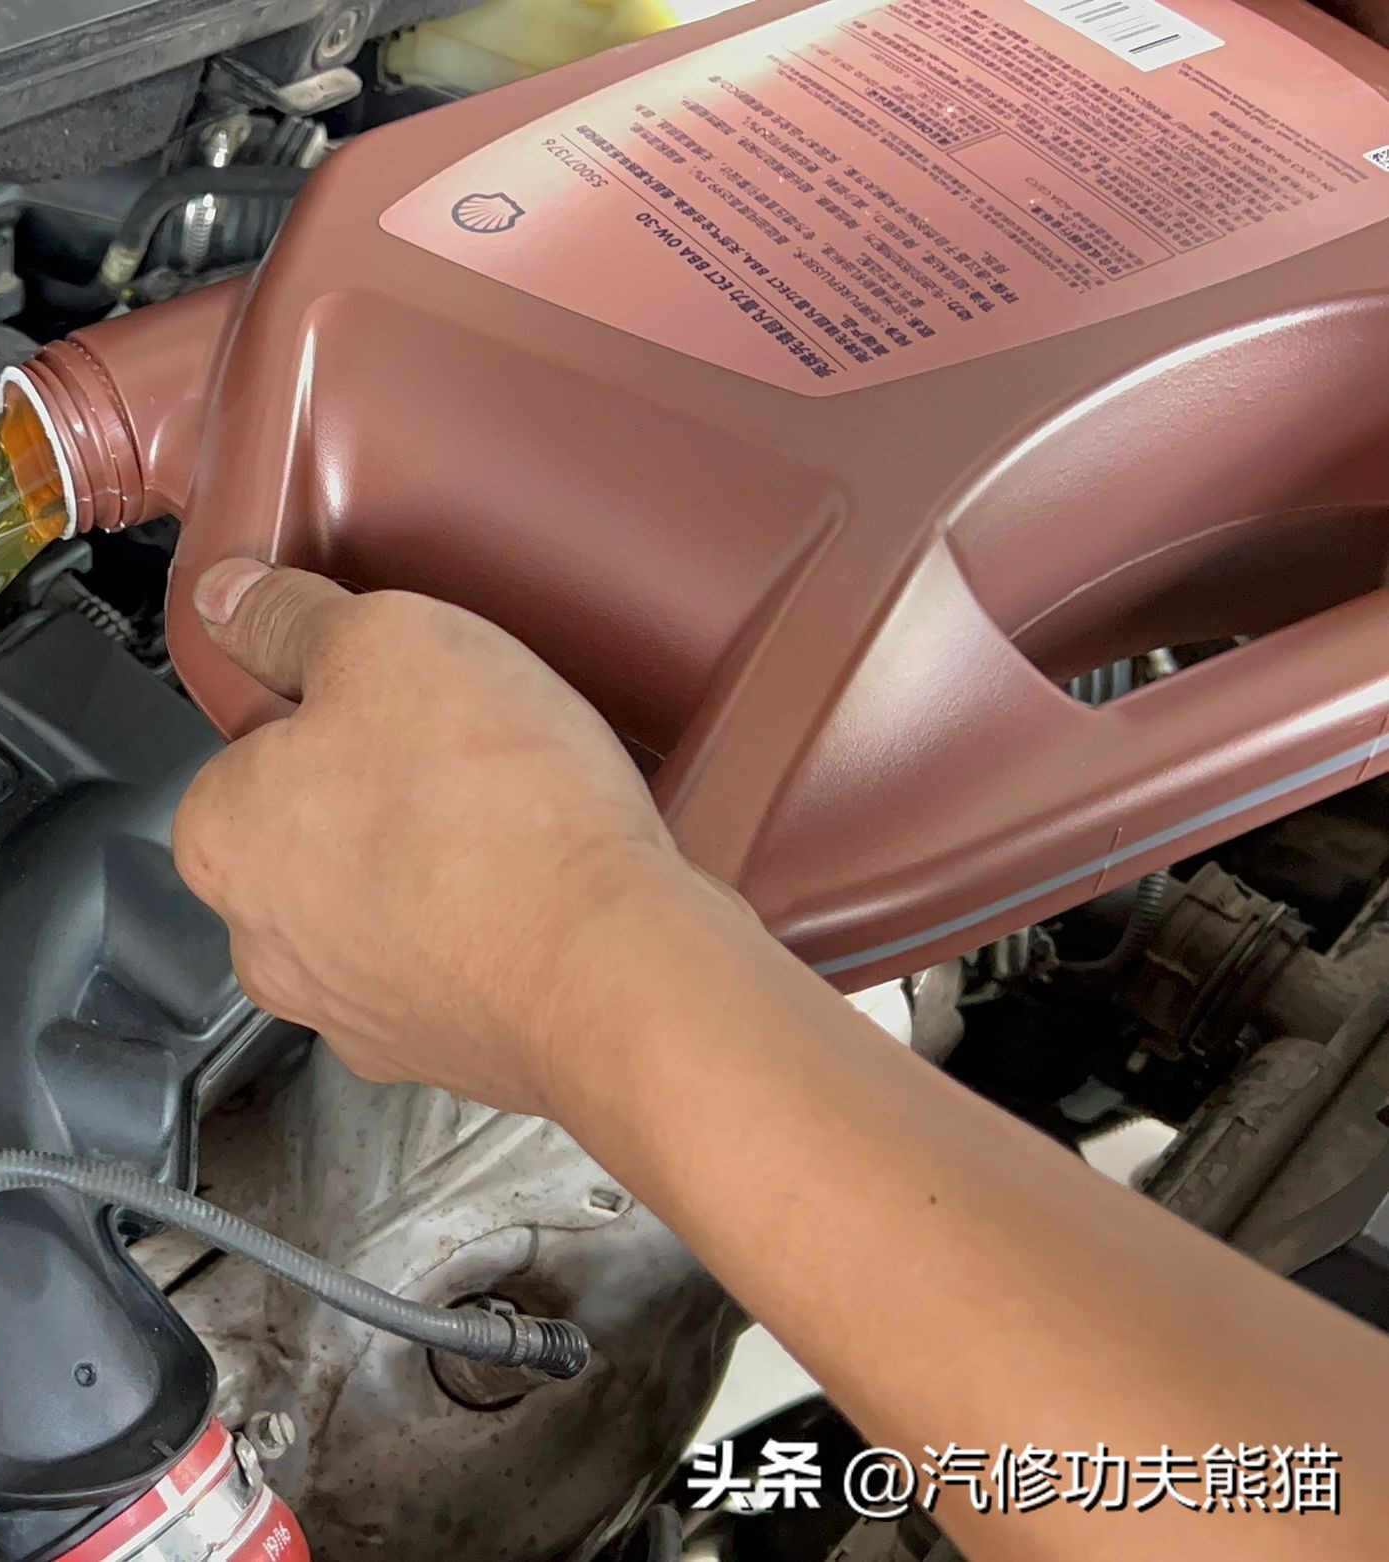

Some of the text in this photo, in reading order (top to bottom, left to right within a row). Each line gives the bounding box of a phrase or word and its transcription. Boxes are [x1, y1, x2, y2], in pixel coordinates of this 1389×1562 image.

[540, 137, 609, 189] 550071376
[633, 210, 839, 378] 壳牌先锋超凡喜力 ECT BBA 0W-30
